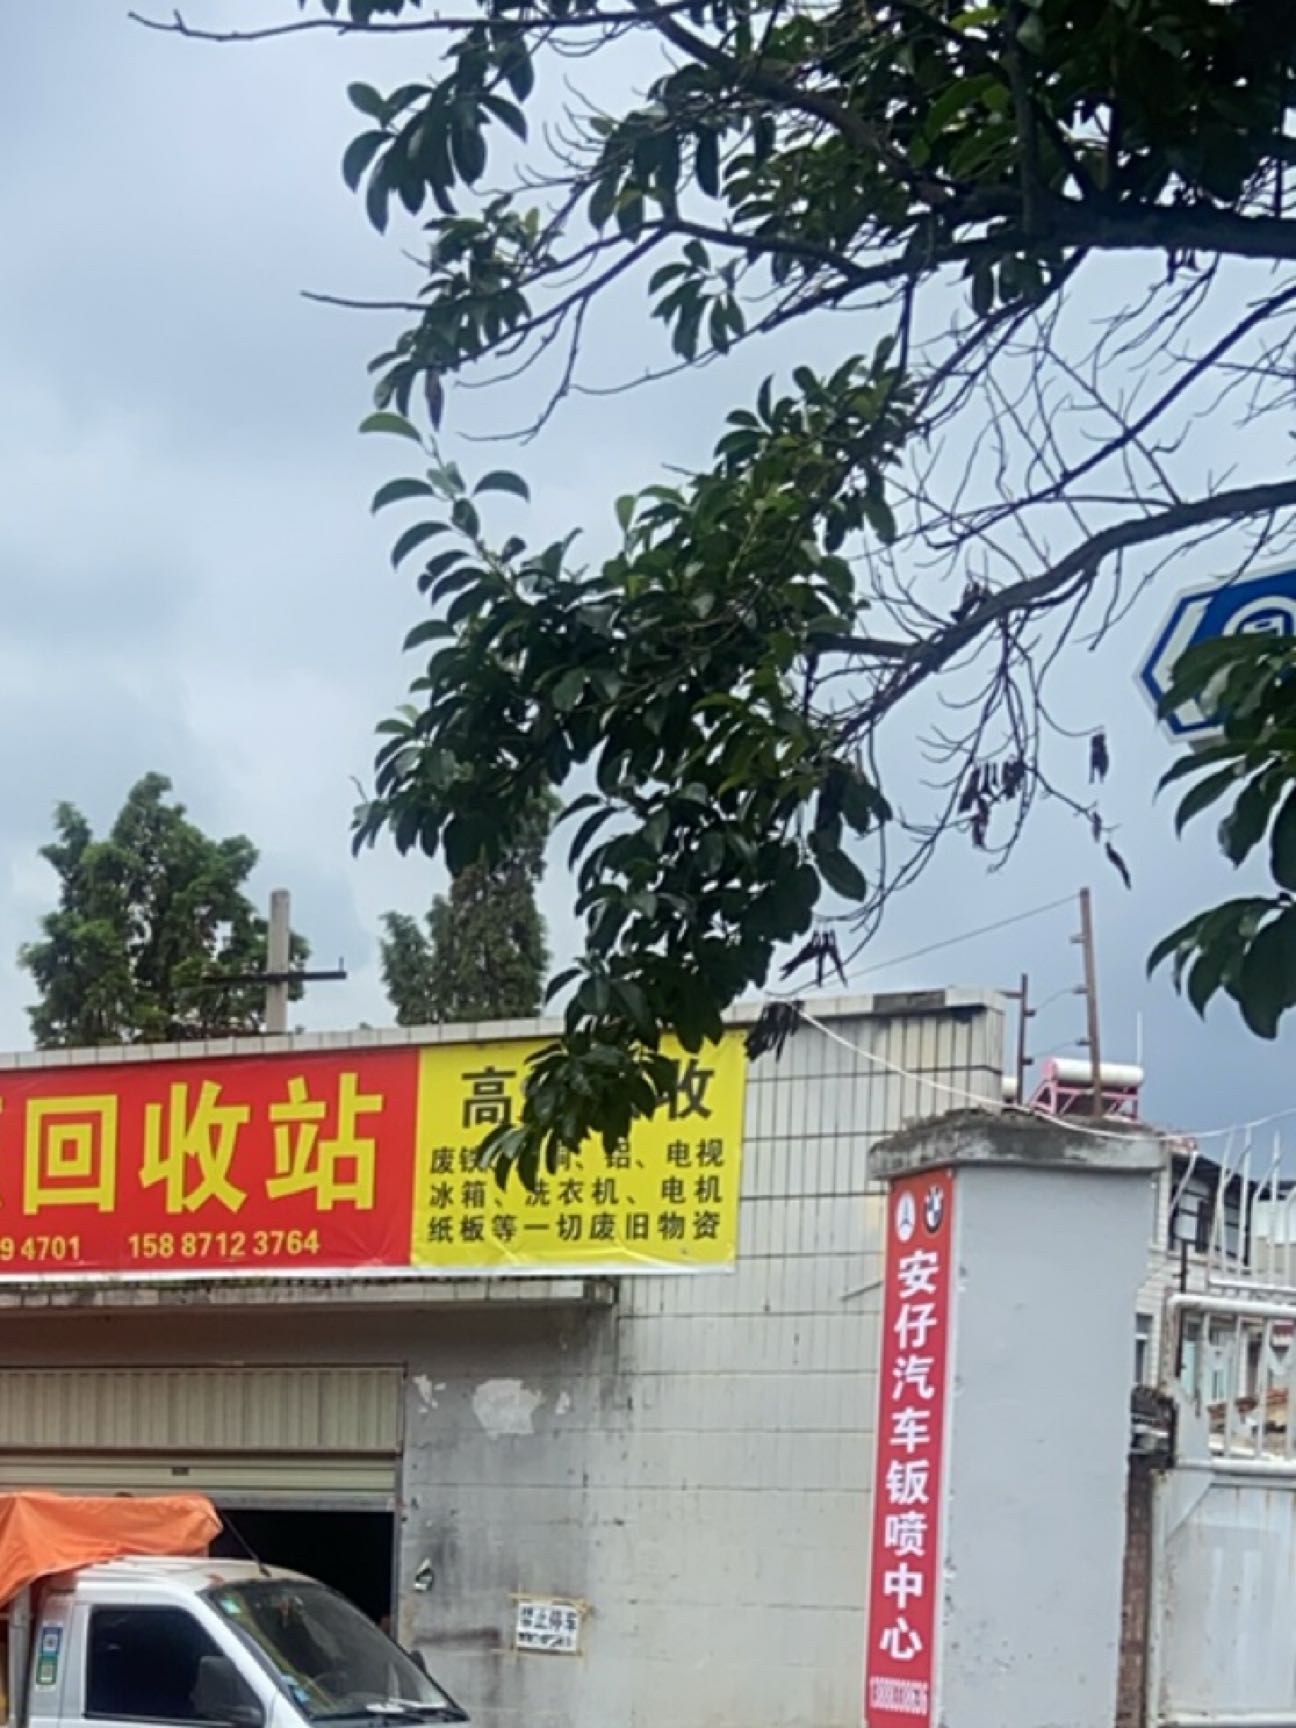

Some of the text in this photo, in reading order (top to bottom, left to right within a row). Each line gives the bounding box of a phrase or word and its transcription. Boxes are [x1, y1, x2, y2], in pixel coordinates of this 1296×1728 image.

[21, 1235, 81, 1260] 4701
[128, 1232, 172, 1258] 158
[180, 1230, 246, 1256] 8712
[253, 1228, 320, 1255] 3764
[428, 1212, 721, 1244] 纸板等一切废旧物资
[879, 1249, 940, 1661] 安仔汽车钣喷中心
